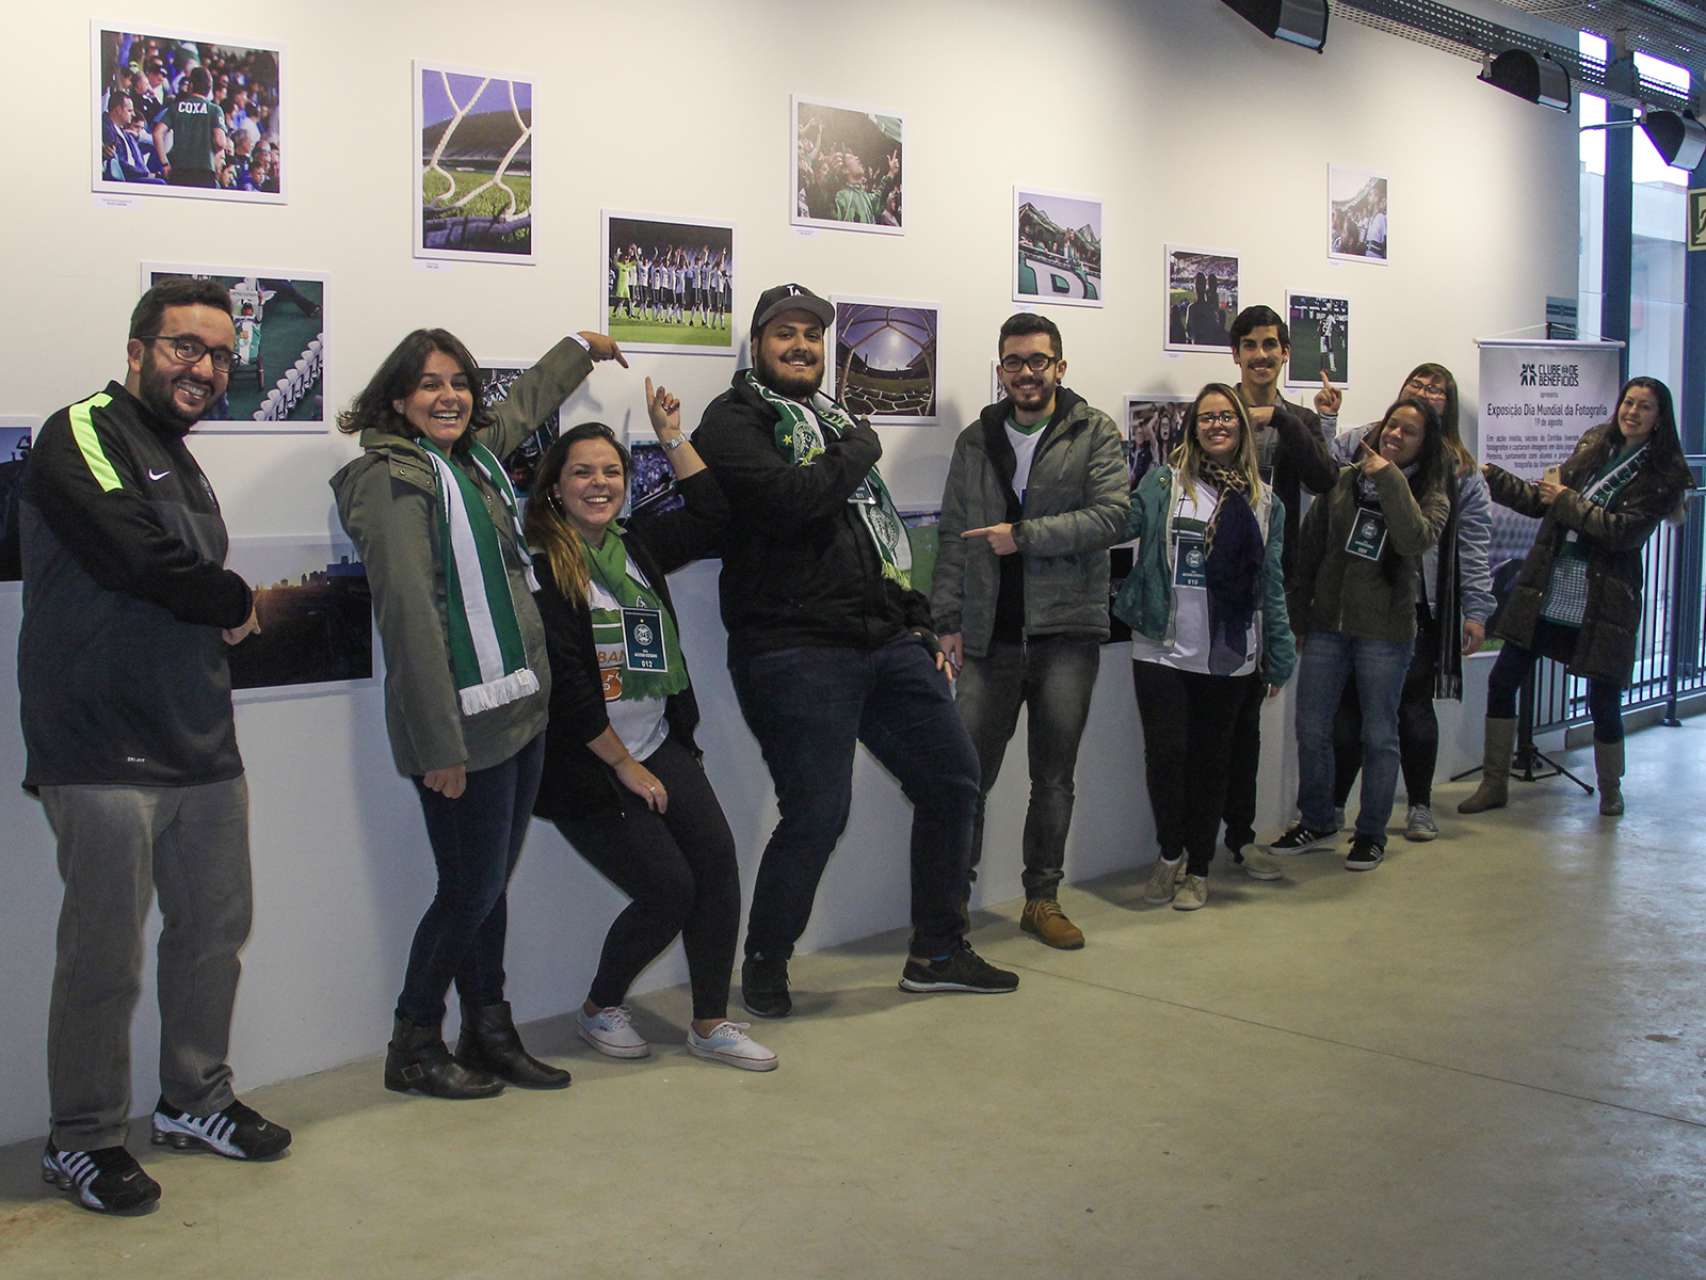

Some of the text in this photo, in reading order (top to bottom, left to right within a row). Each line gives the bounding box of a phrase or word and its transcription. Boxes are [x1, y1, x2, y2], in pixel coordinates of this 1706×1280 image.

[178, 101, 208, 114] COXA
[1538, 364, 1561, 375] CLUBE
[1487, 403, 1607, 419] Exposição Dia Mundial da Fotografia
